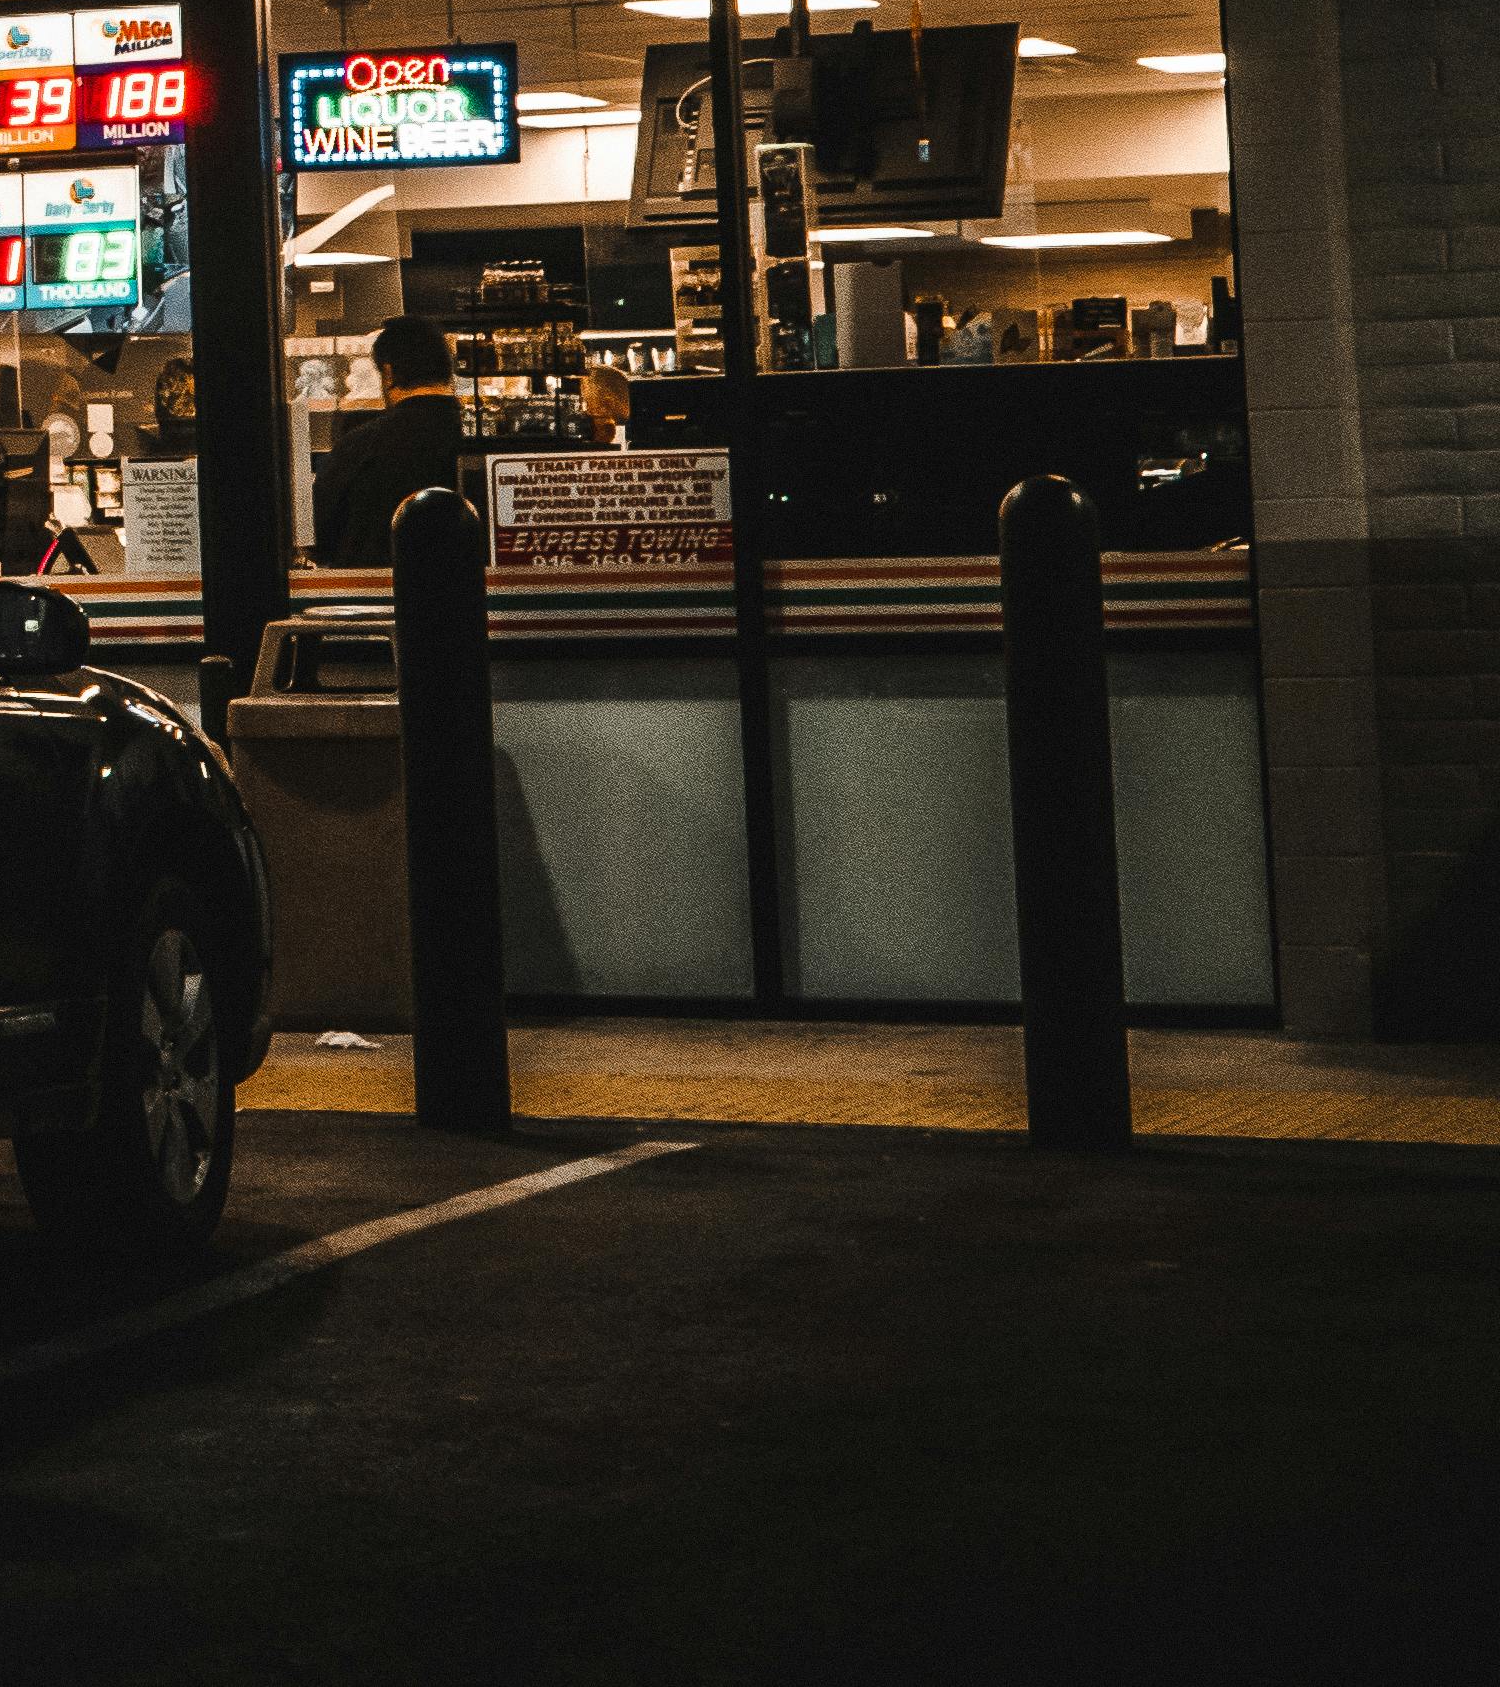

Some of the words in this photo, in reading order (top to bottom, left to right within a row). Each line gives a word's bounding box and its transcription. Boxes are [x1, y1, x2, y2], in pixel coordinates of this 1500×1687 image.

[116, 18, 173, 43] MEGA
[114, 36, 174, 57] MILLIONS
[346, 56, 450, 95] Open
[9, 78, 74, 126] 39
[106, 69, 186, 120] 188
[317, 90, 466, 128] LIQUOR
[103, 122, 170, 140] MILLION
[302, 126, 394, 153] WINE
[64, 230, 135, 282] 83
[39, 281, 131, 301] THOUSAND
[498, 473, 611, 485] UNAUTHORIZED
[614, 472, 634, 482] OR
[638, 470, 726, 482] IMPROPERLY
[526, 460, 585, 473] TENANT
[589, 459, 654, 471] PARKING
[658, 457, 698, 469] ONLY
[513, 486, 571, 498] PARKED
[576, 484, 646, 496] VEHICLES
[513, 498, 595, 510] IMPOUNDED
[512, 529, 620, 552] EXPRESS
[626, 527, 720, 551] TOWING
